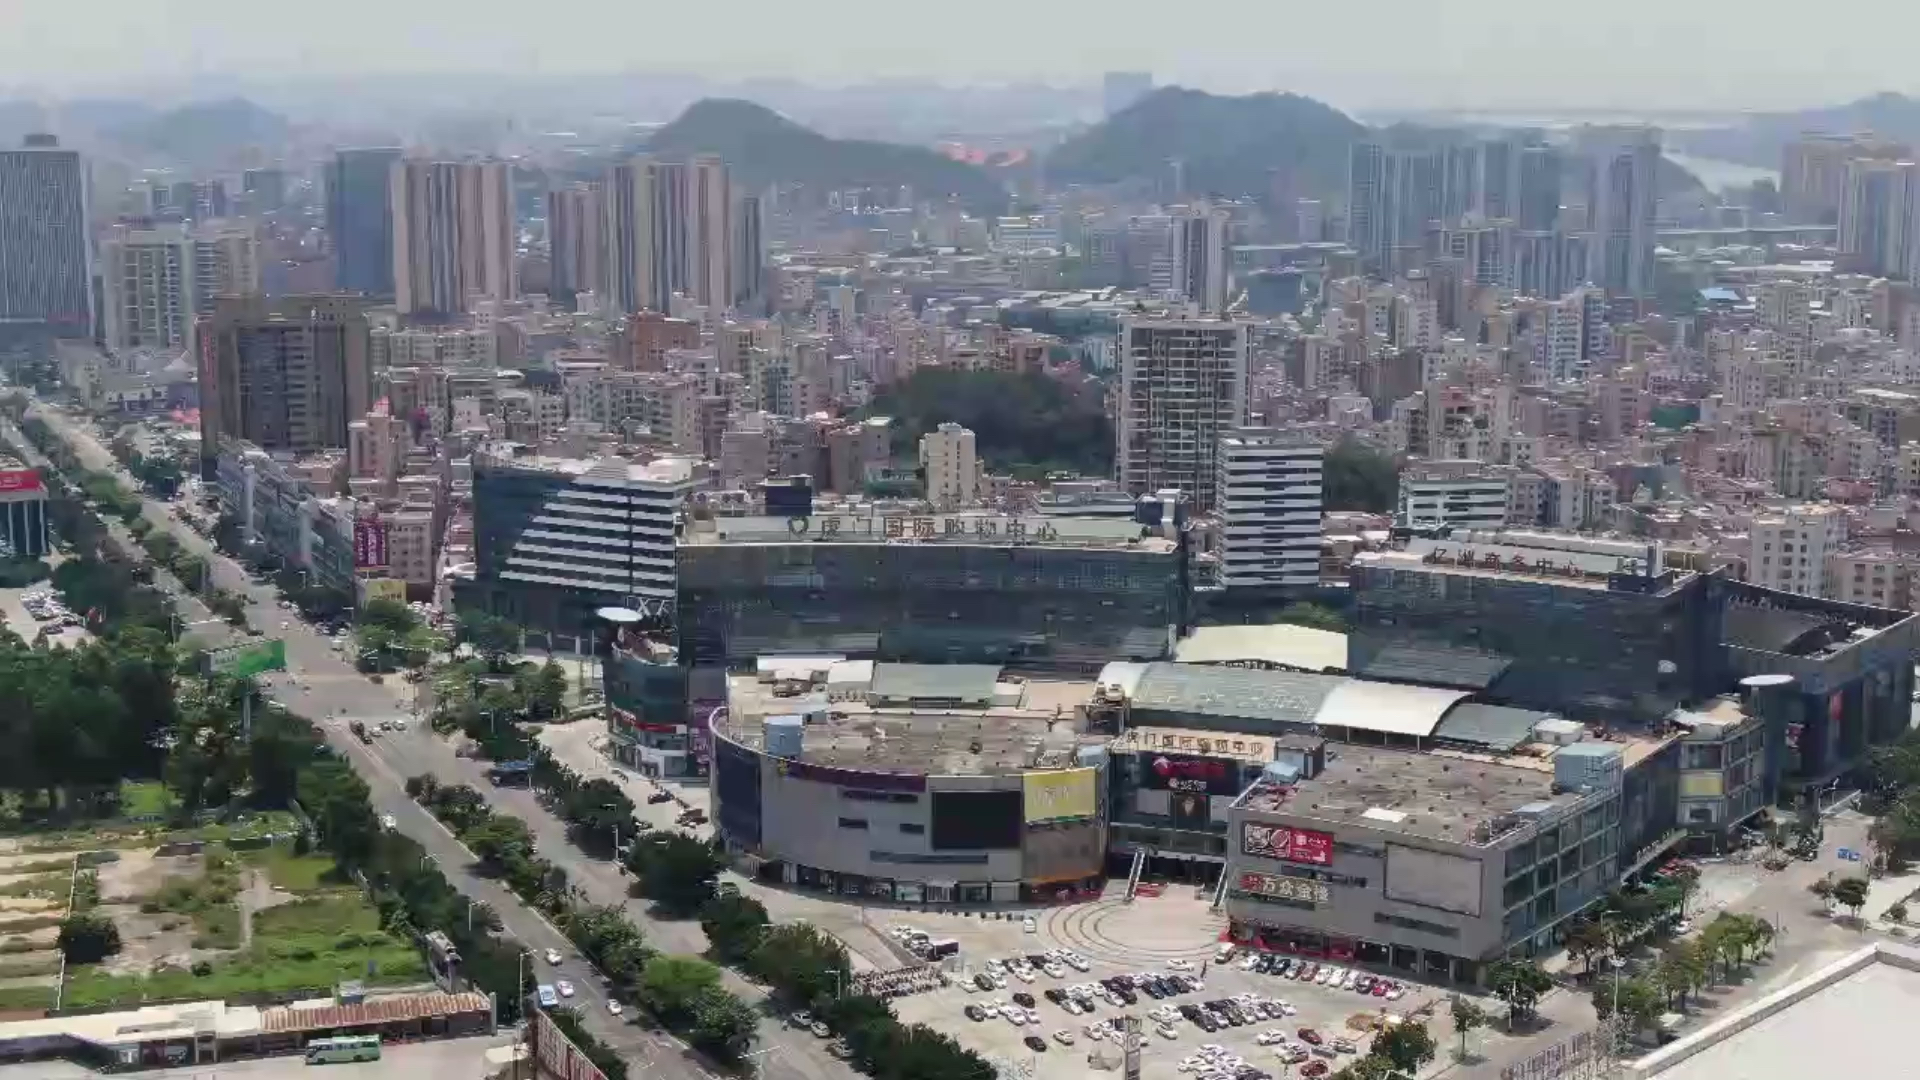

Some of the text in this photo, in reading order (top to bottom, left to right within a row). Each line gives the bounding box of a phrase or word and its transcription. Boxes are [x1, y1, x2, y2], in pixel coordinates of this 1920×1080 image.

[821, 515, 1057, 541] 虎门国际购物中心
